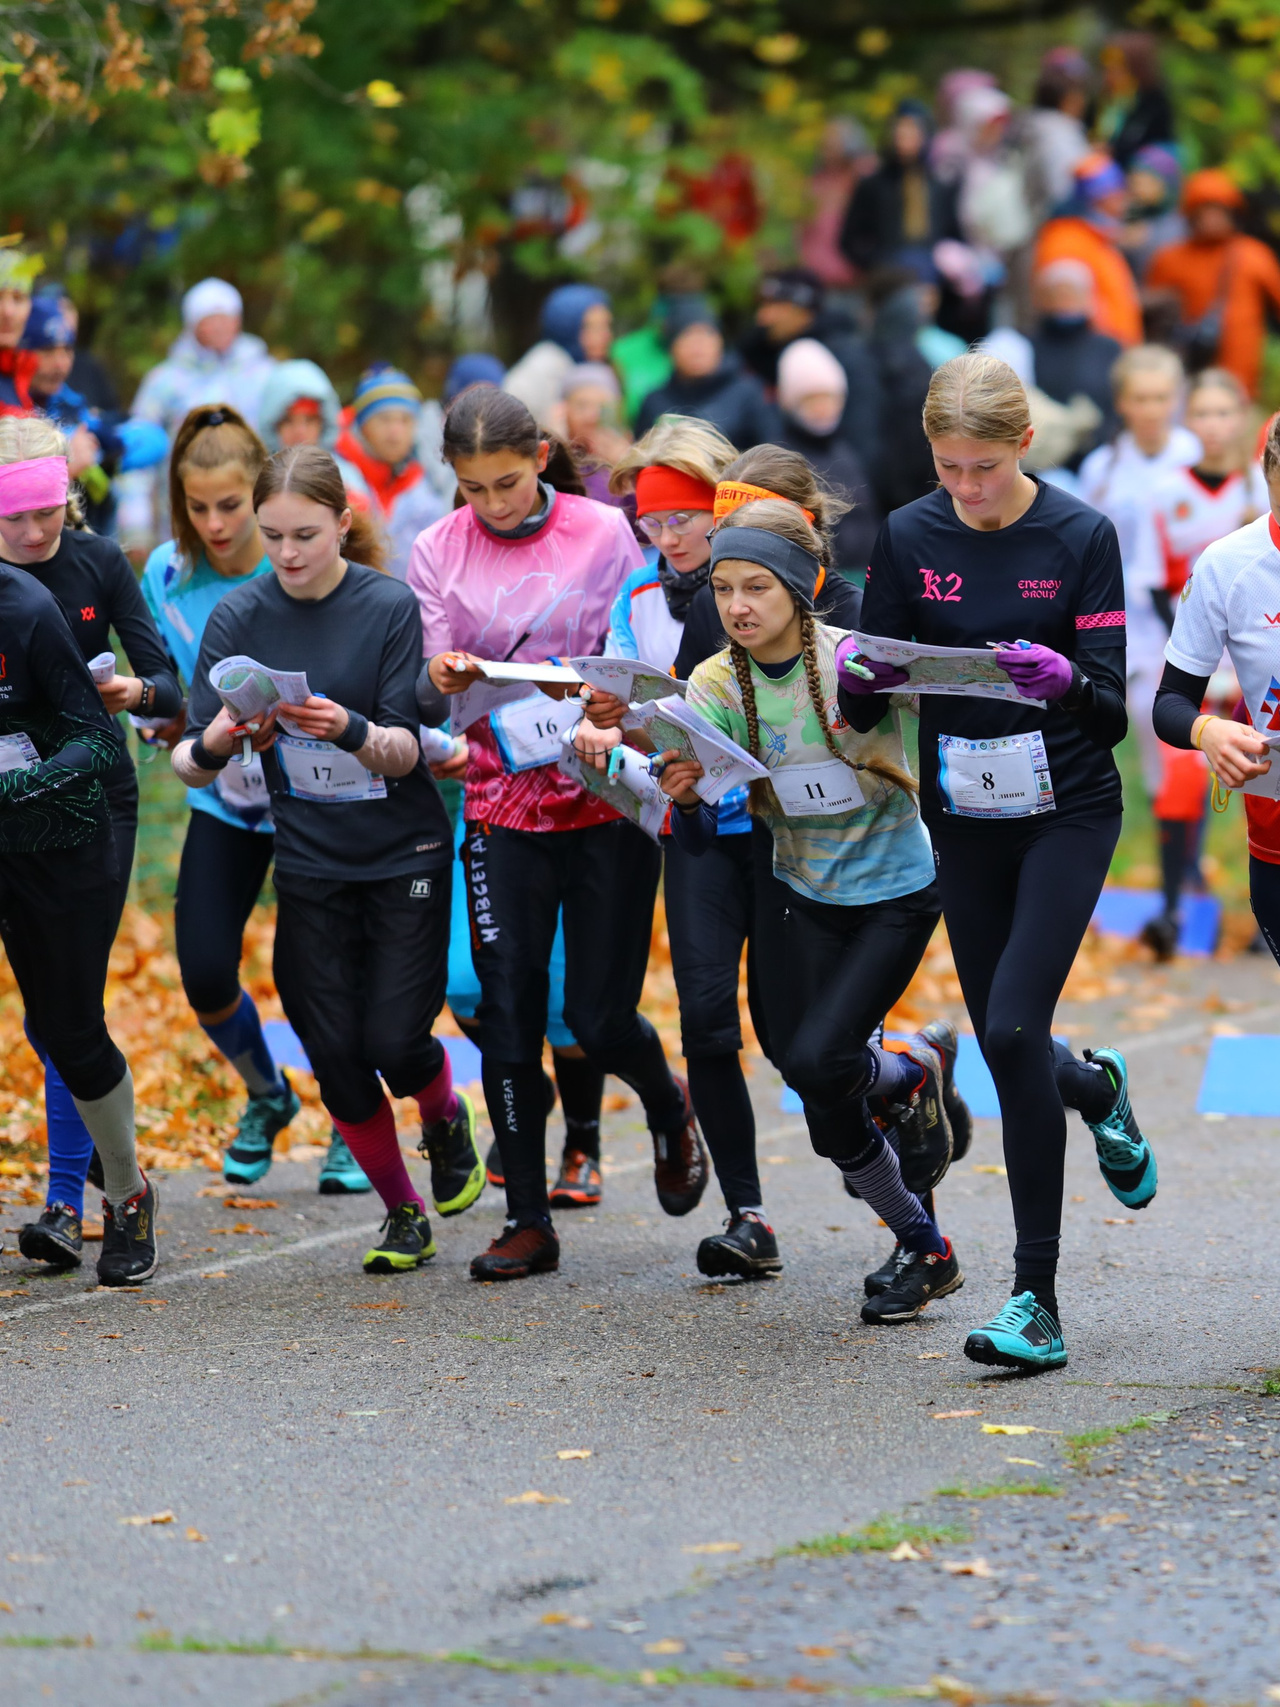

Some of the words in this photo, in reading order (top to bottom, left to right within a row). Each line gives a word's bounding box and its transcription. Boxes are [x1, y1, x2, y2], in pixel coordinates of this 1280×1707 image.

[1017, 579, 1062, 591] ENERGY
[1021, 590, 1057, 600] GROUP
[534, 717, 559, 739] 16
[313, 765, 332, 781] 17
[981, 772, 995, 791] 8
[803, 782, 826, 799] 11
[998, 792, 1026, 800] линия
